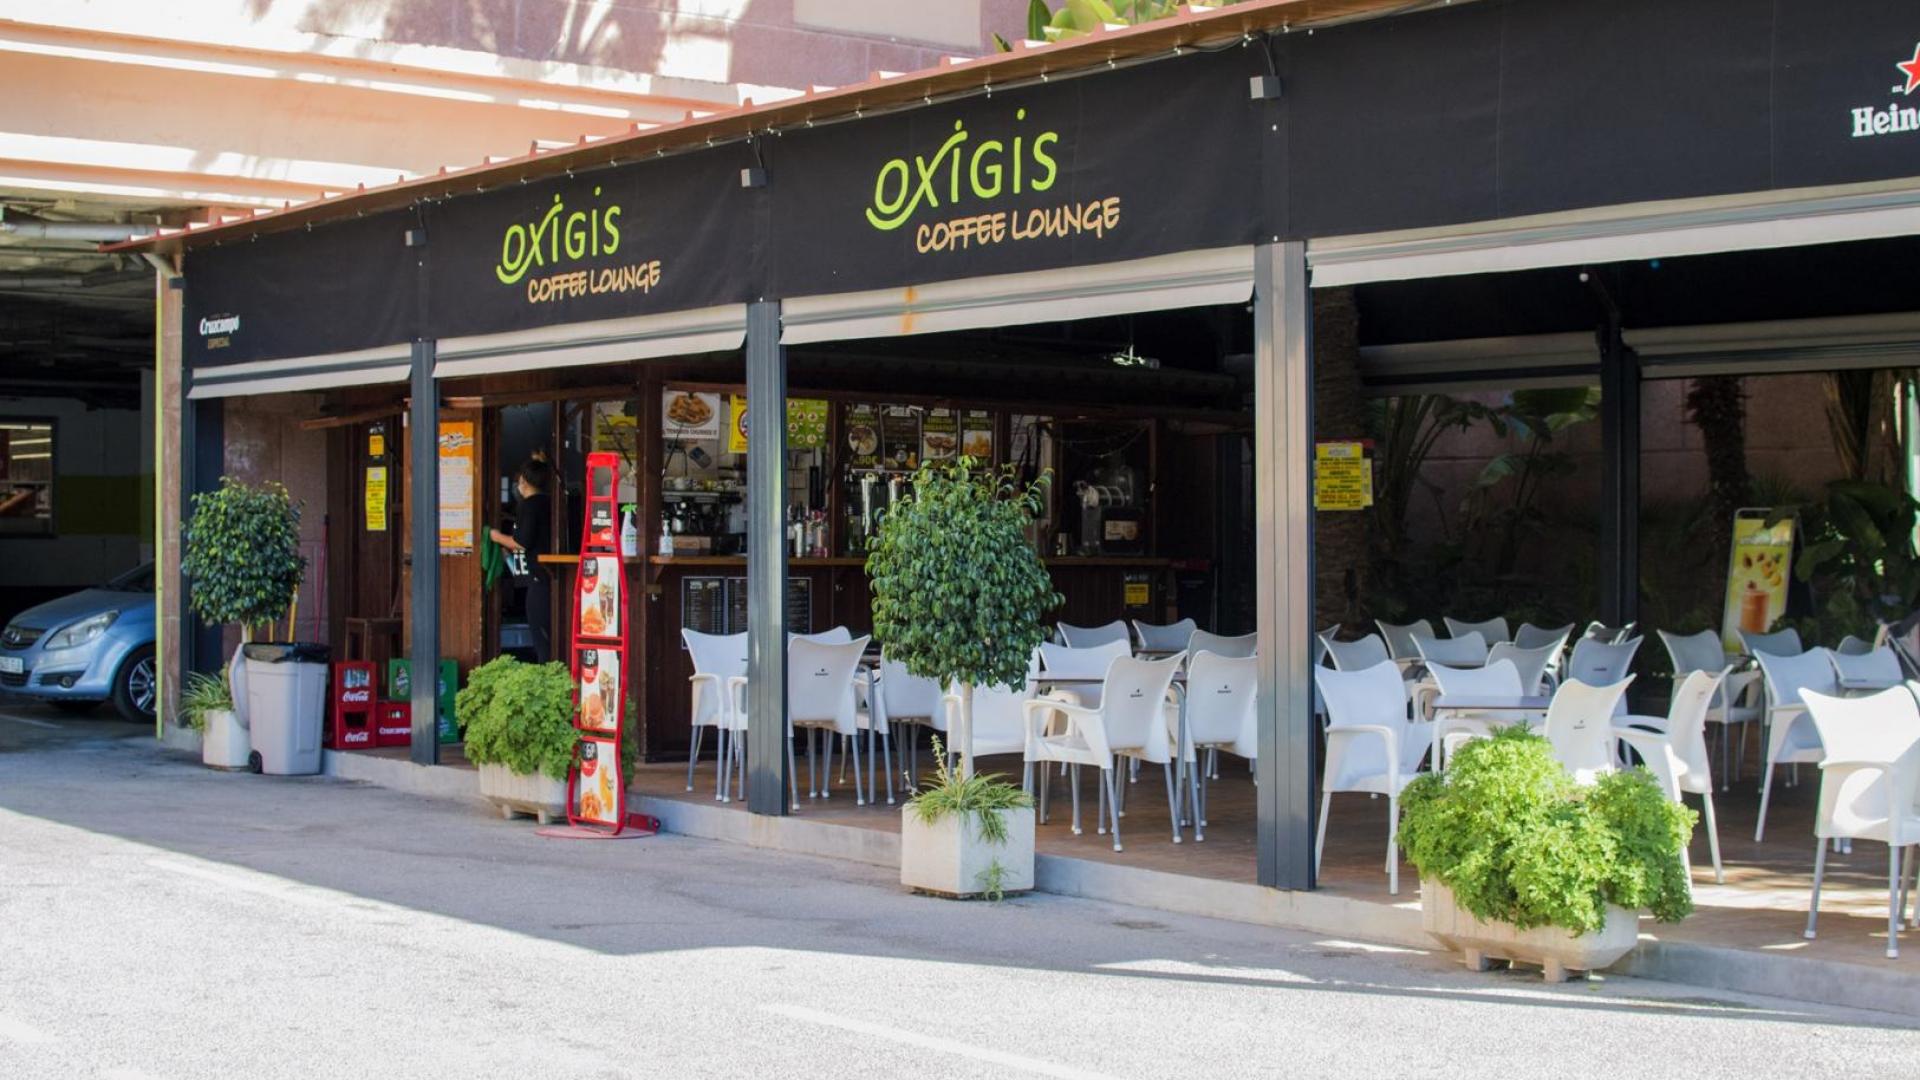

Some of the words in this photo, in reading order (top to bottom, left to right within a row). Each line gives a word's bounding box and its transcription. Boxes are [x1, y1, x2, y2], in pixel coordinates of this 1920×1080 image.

[1851, 103, 1920, 137] Hein
[917, 212, 1006, 253] COFFEE
[1012, 197, 1120, 240] LOUNGE
[528, 271, 587, 303] COFFEE
[590, 260, 661, 294] LOUNGE
